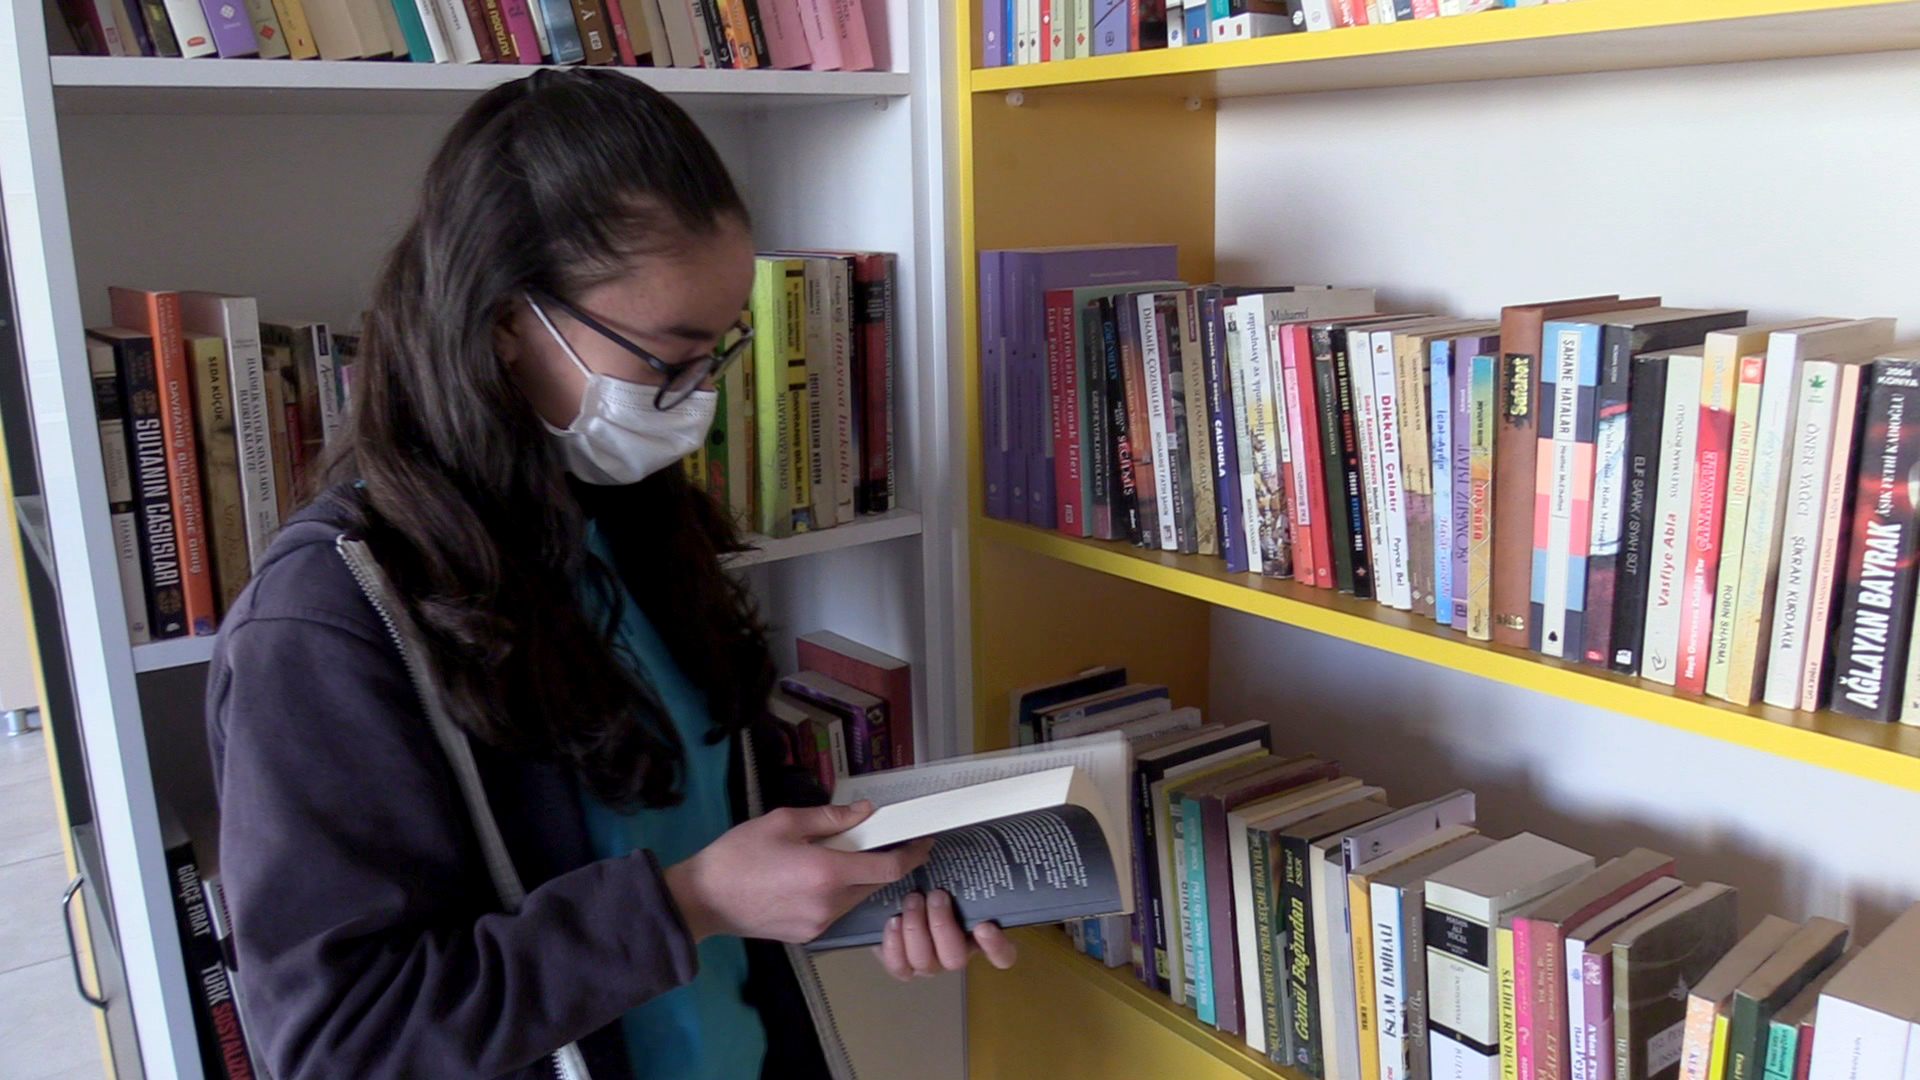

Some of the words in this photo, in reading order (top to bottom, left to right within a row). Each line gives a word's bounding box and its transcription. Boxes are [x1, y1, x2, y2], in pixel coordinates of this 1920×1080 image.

[1142, 307, 1161, 356] DİNAMİK
[207, 356, 220, 383] SEDA
[1147, 358, 1164, 419] ÇÖZÜMLEME
[1510, 357, 1529, 416] Safahat
[167, 381, 188, 449] DAVRANIŞ
[210, 385, 226, 421] KÜÇÜK
[1067, 389, 1079, 440] Parmak
[1380, 395, 1396, 454] Dikkat!
[1558, 387, 1573, 434] HATALAR
[135, 419, 169, 498] SULTANIN
[1214, 419, 1227, 478] CALIGULA
[1803, 423, 1821, 465] ÖNER
[176, 453, 198, 534] BİLİMLERİNE
[1386, 462, 1399, 513] Çatlatır
[144, 503, 181, 588] CASUSLARI
[1663, 512, 1677, 549] Abla
[1656, 552, 1676, 607] Vasfiye
[1788, 536, 1807, 585] ŞÜKRAN
[1857, 519, 1902, 609] BAYRAK
[1720, 585, 1733, 618] ROBIN
[1780, 590, 1798, 651] KURDAKUL
[1715, 620, 1729, 666] SHARMA
[1838, 609, 1890, 710] AĞLAYAN
[176, 863, 205, 904] GÖKÇE
[190, 902, 212, 939] FIRAT
[1287, 896, 1311, 985] Bağından
[200, 960, 231, 1006] TÜRK
[1378, 924, 1396, 989] İLMİHALİ
[1292, 984, 1310, 1041] Gönül
